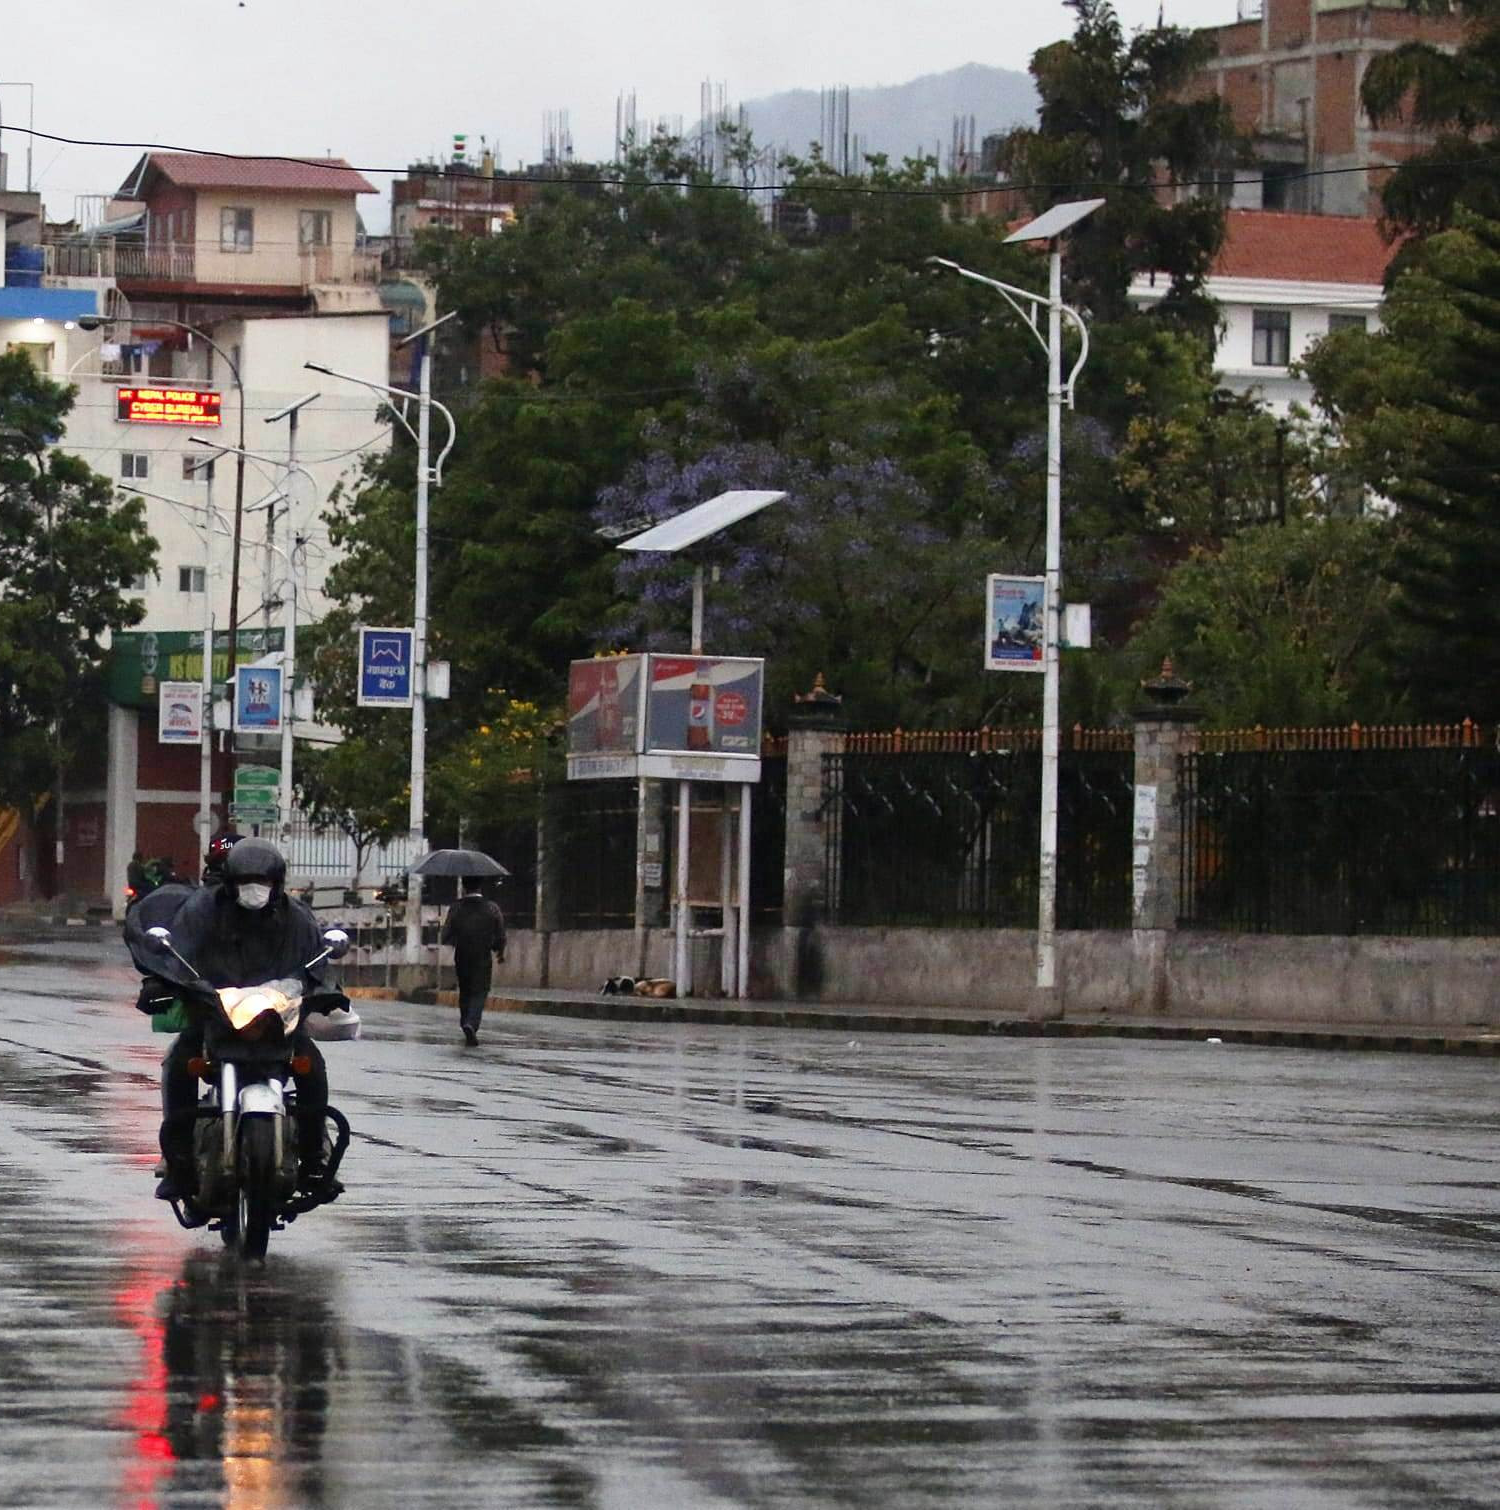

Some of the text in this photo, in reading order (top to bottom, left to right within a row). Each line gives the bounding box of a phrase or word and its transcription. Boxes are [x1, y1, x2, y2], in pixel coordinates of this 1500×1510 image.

[165, 392, 196, 401] POLICE
[131, 402, 204, 414] CYBER BUREAU
